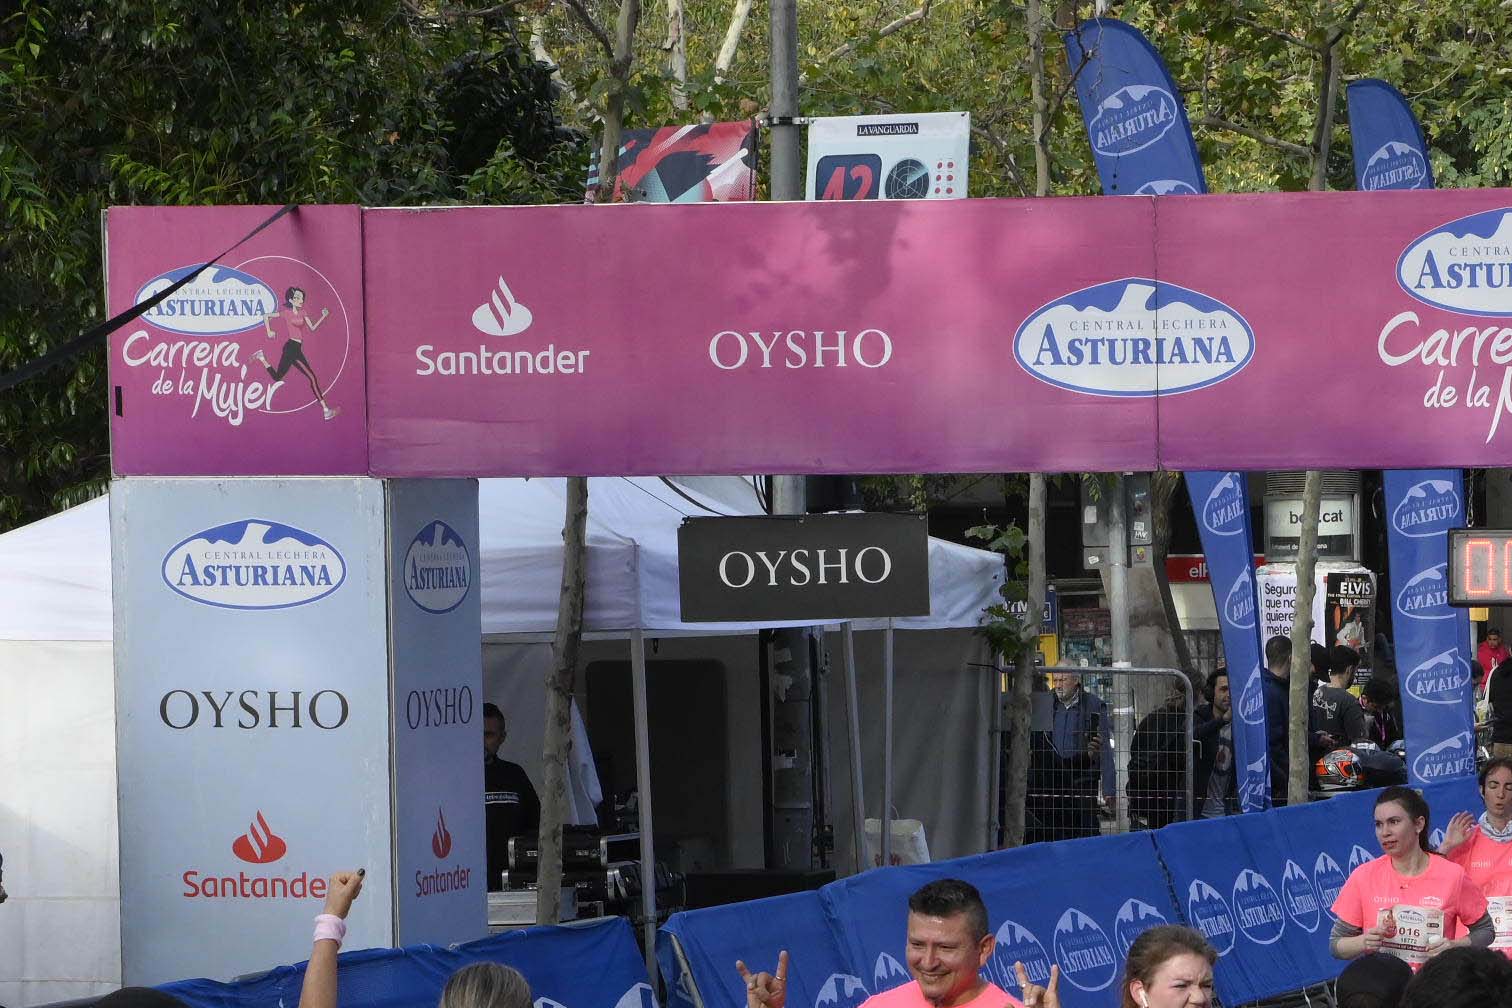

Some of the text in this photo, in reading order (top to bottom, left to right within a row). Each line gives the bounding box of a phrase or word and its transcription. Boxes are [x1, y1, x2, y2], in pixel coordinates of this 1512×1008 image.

[869, 123, 918, 135] VANGUARDIA
[1069, 317, 1228, 331] CENTRAL LECHERA
[122, 330, 241, 368] Carrera
[415, 343, 590, 377] Santander
[709, 328, 894, 370] OYSHO
[1032, 322, 1236, 368] ASTURIANA
[152, 364, 285, 426] de la Mujer
[1424, 370, 1458, 409] de
[1466, 365, 1491, 409] la
[176, 553, 333, 587] ASTURIANA
[205, 550, 326, 560] CENTRAL LECHERA
[718, 545, 892, 588] OYSHO
[409, 556, 468, 591] ASTURIANA
[1340, 582, 1371, 595] ELVIS
[1265, 600, 1281, 610] que
[159, 689, 349, 729] OYSHO
[406, 685, 473, 730] OYSHO
[183, 870, 327, 899] Santande
[415, 865, 471, 898] Santander
[1398, 927, 1420, 937] 016
[1059, 942, 1114, 974] ASTURIANA
